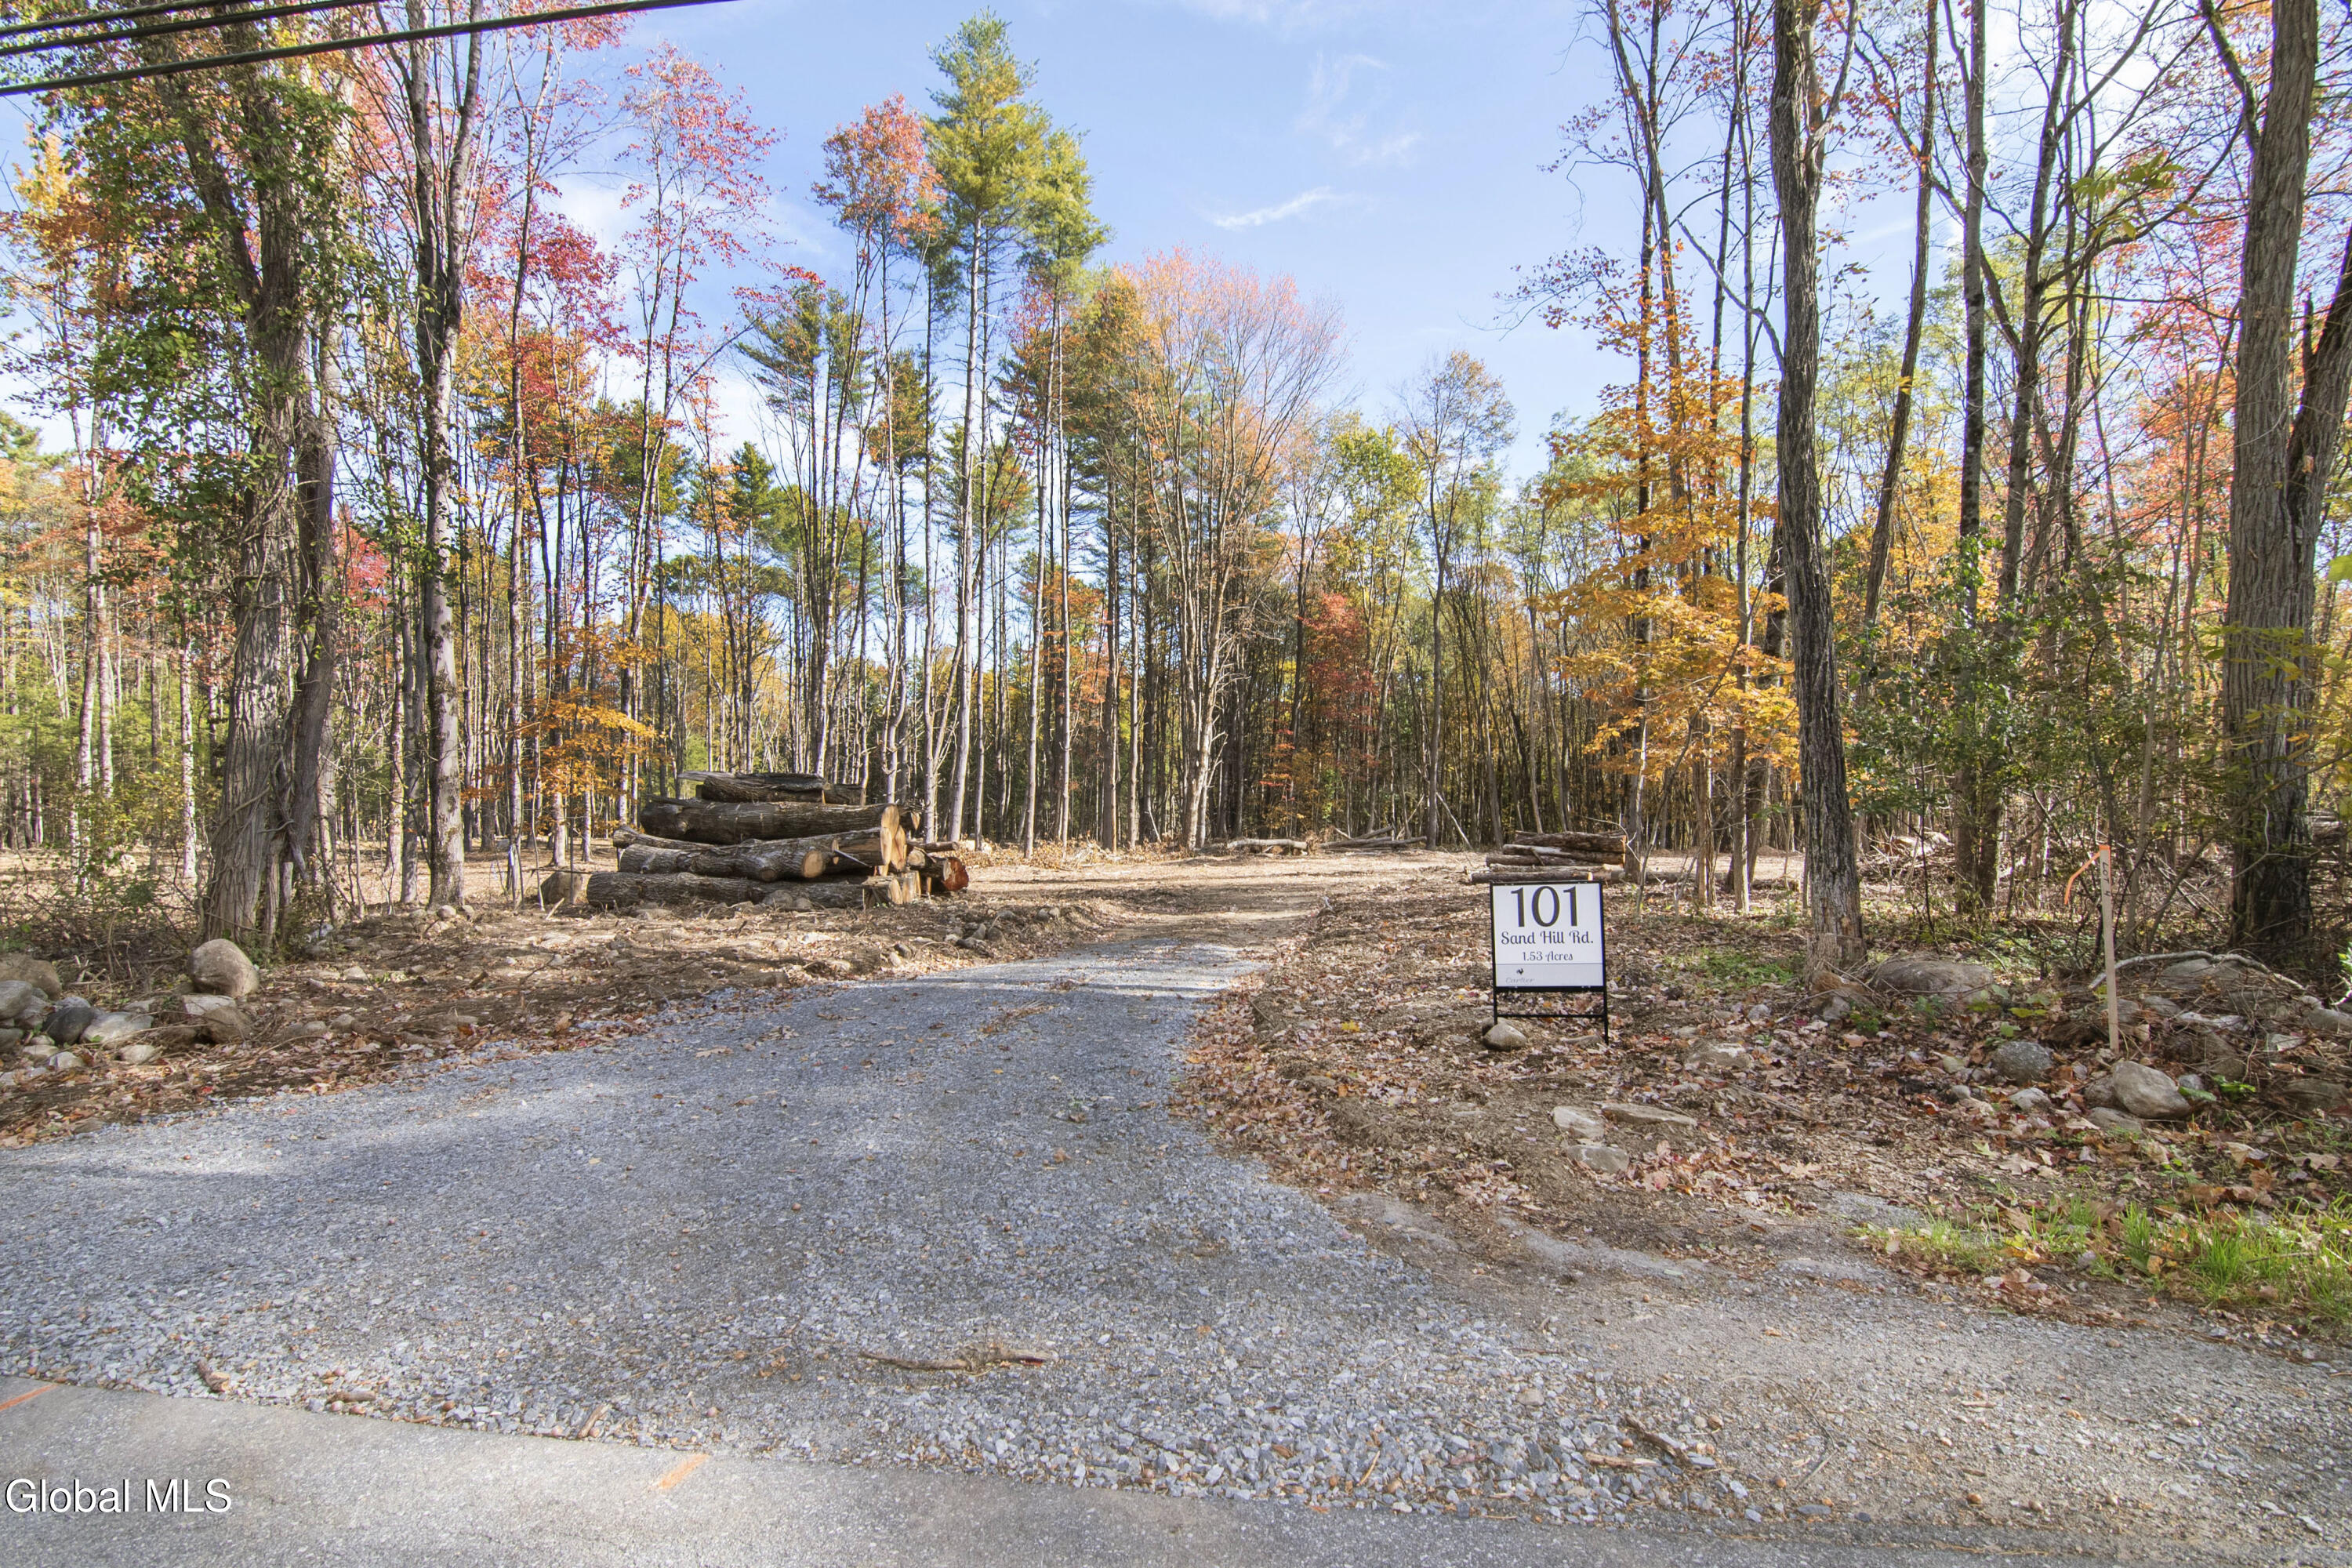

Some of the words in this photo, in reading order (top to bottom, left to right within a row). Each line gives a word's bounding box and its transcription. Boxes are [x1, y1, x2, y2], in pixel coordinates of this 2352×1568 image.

[1511, 886, 1577, 927] 101
[1501, 931, 1536, 945] Sand
[1540, 931, 1565, 944] Hill
[1569, 930, 1594, 944] Rd.
[1523, 951, 1543, 961] 1.53
[1545, 951, 1573, 962] Acres
